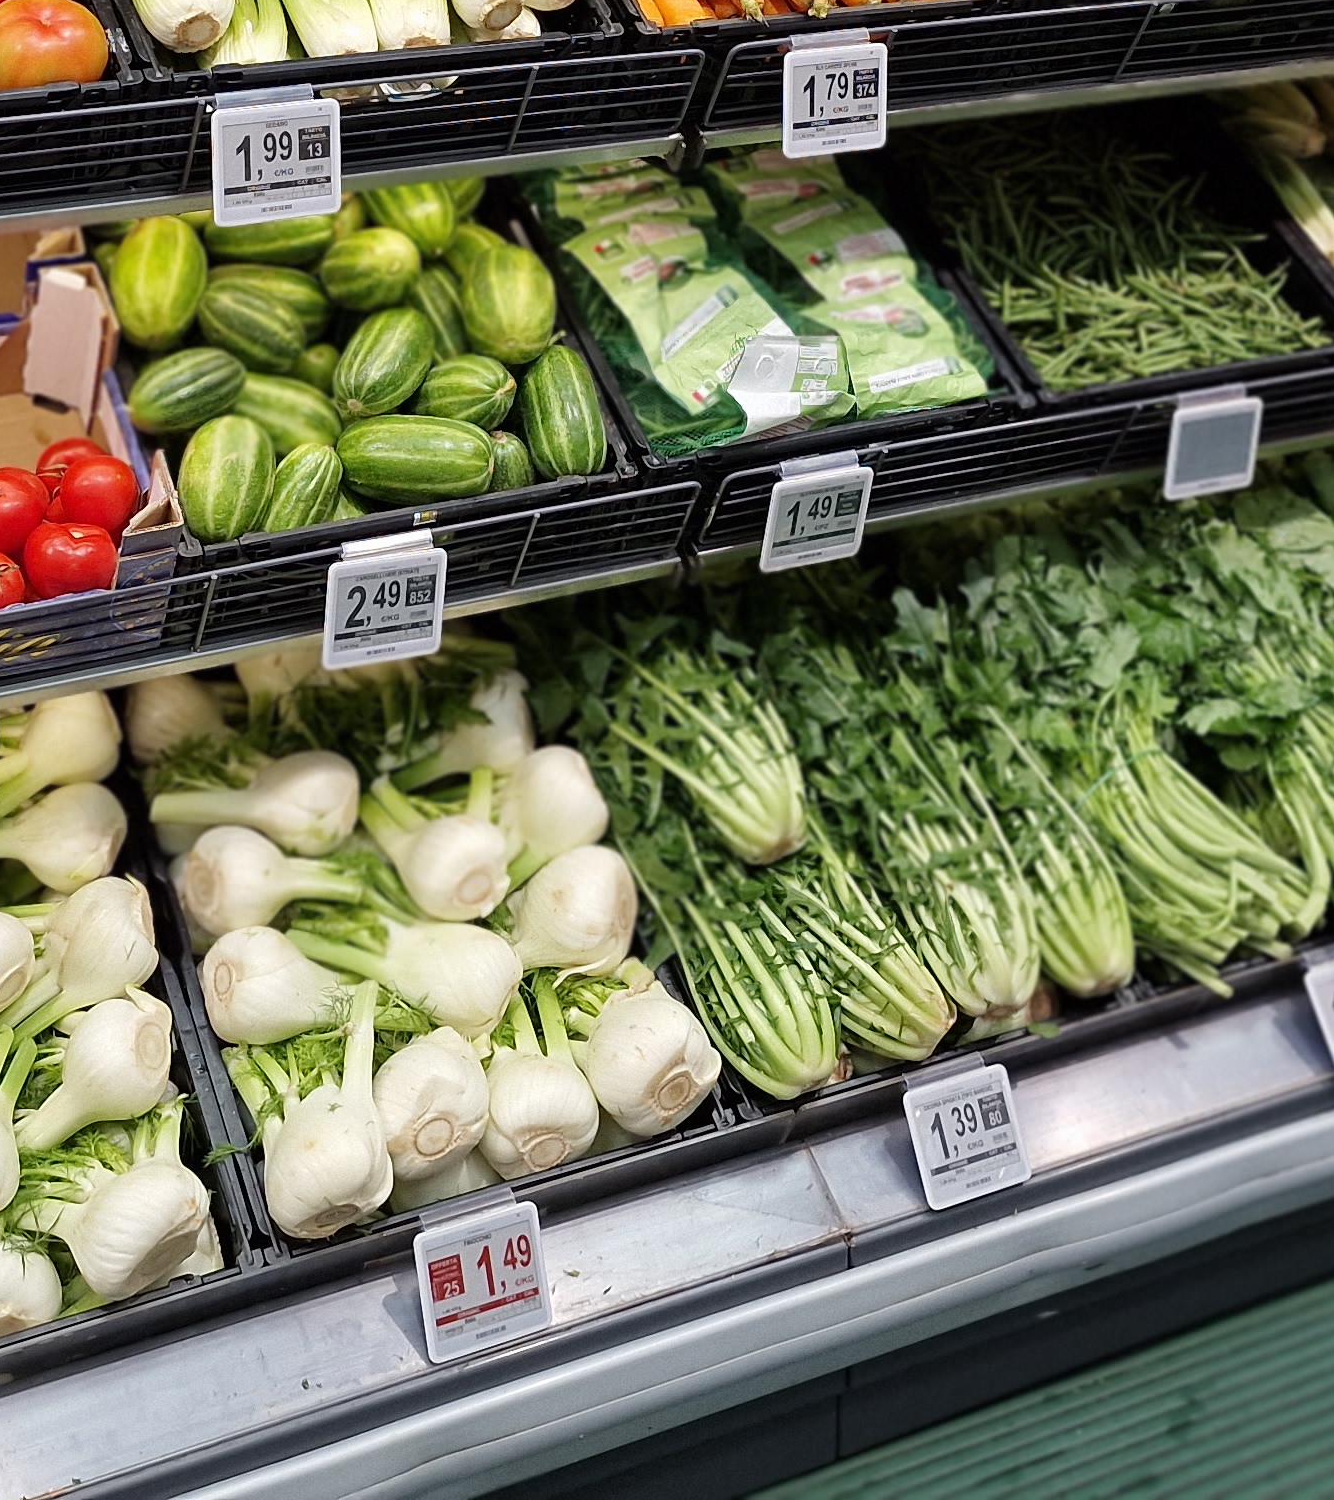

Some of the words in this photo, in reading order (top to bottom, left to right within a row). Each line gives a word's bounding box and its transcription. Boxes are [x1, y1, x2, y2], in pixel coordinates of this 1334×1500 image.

[803, 72, 848, 117] 1,79
[856, 84, 875, 97] 374
[236, 131, 292, 181] 1,99
[307, 142, 322, 157] 13
[787, 496, 832, 536] 1,49
[345, 580, 400, 629] 2,49
[409, 590, 432, 604] 852
[931, 1103, 978, 1159] 1,39
[988, 1110, 1002, 1126] 80
[477, 1234, 532, 1297] 1,49
[443, 1280, 460, 1298] 25
